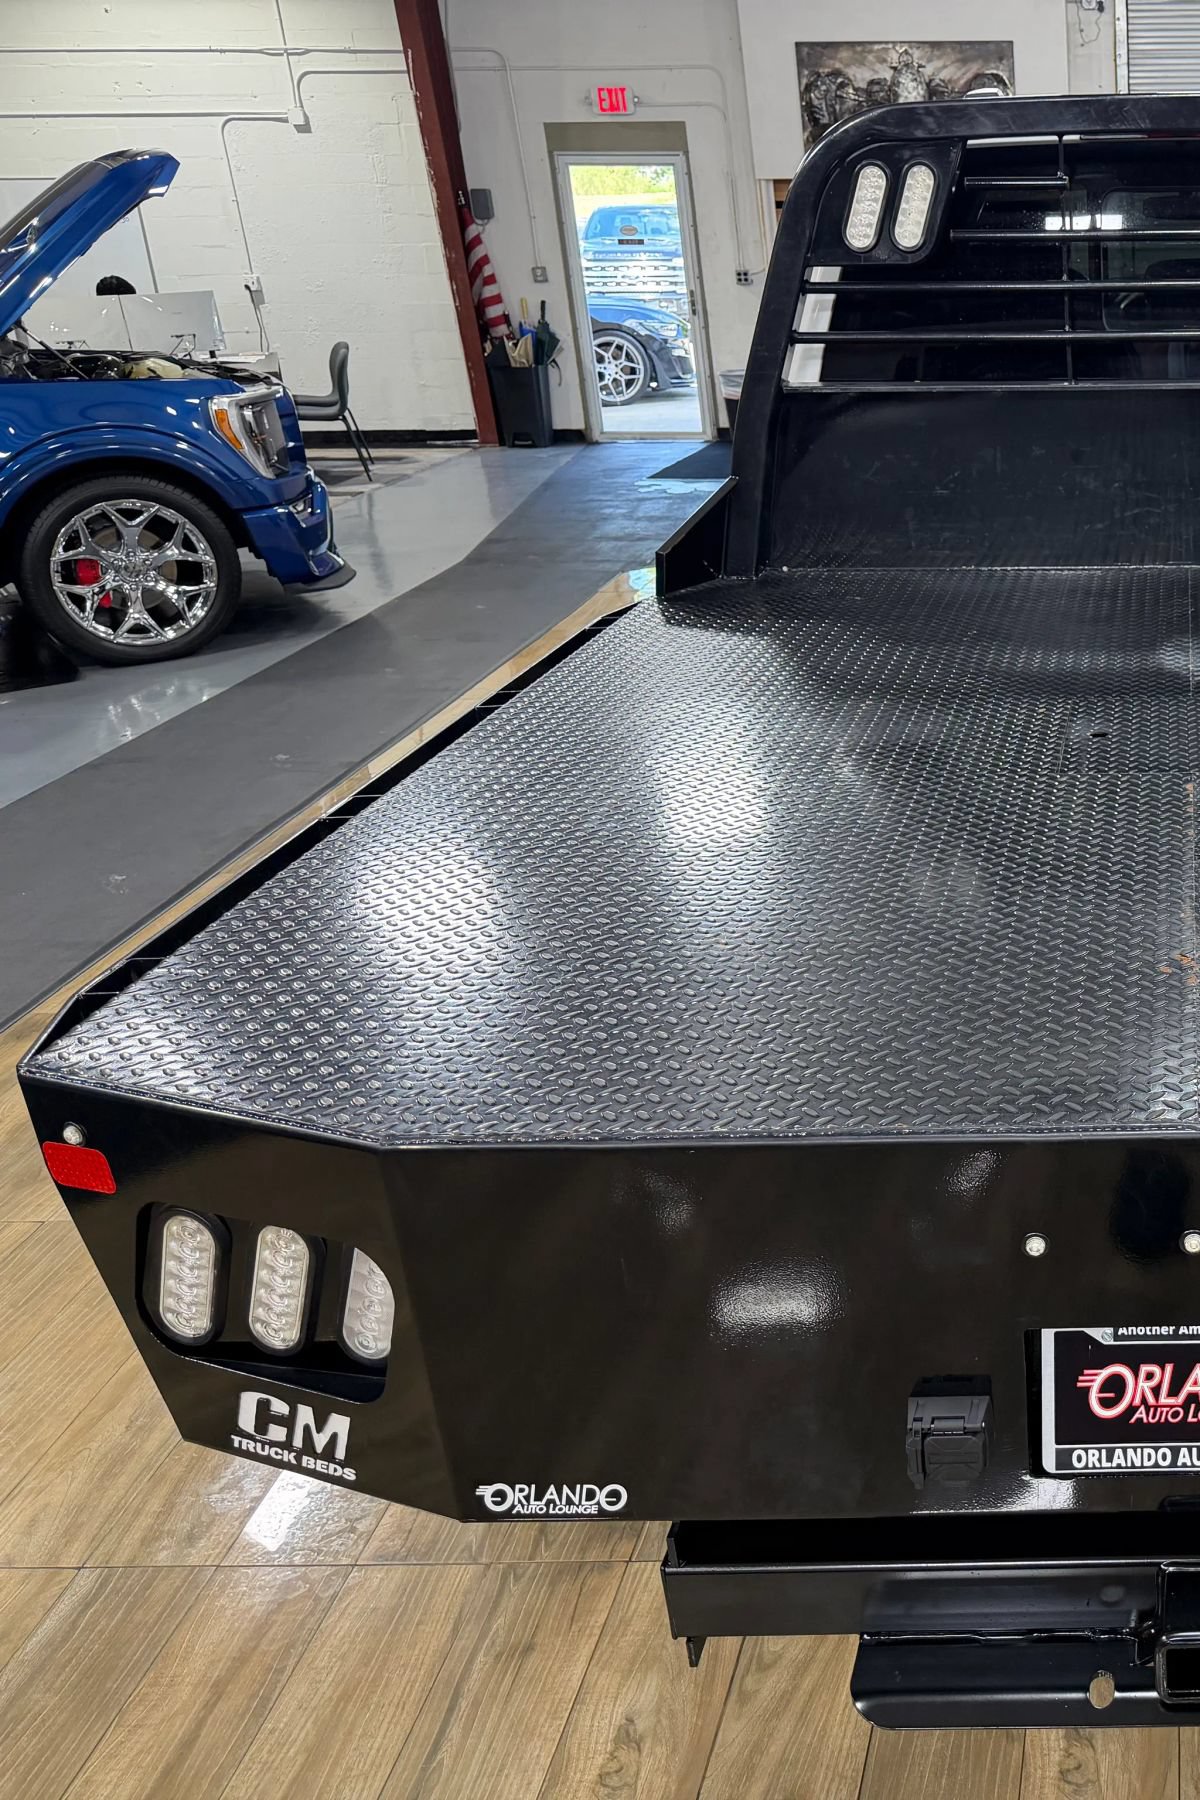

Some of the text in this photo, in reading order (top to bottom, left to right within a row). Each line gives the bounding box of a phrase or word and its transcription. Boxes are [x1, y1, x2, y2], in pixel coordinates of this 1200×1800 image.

[597, 87, 627, 113] EXIT
[237, 1391, 351, 1461] CM
[1128, 1405, 1184, 1424] AUTO
[230, 1434, 357, 1481] TRUCK BEDS
[1071, 1448, 1172, 1469] ORLANDO
[475, 1482, 628, 1512] ORLANDO
[512, 1503, 599, 1514] AUTO LOUNGE
